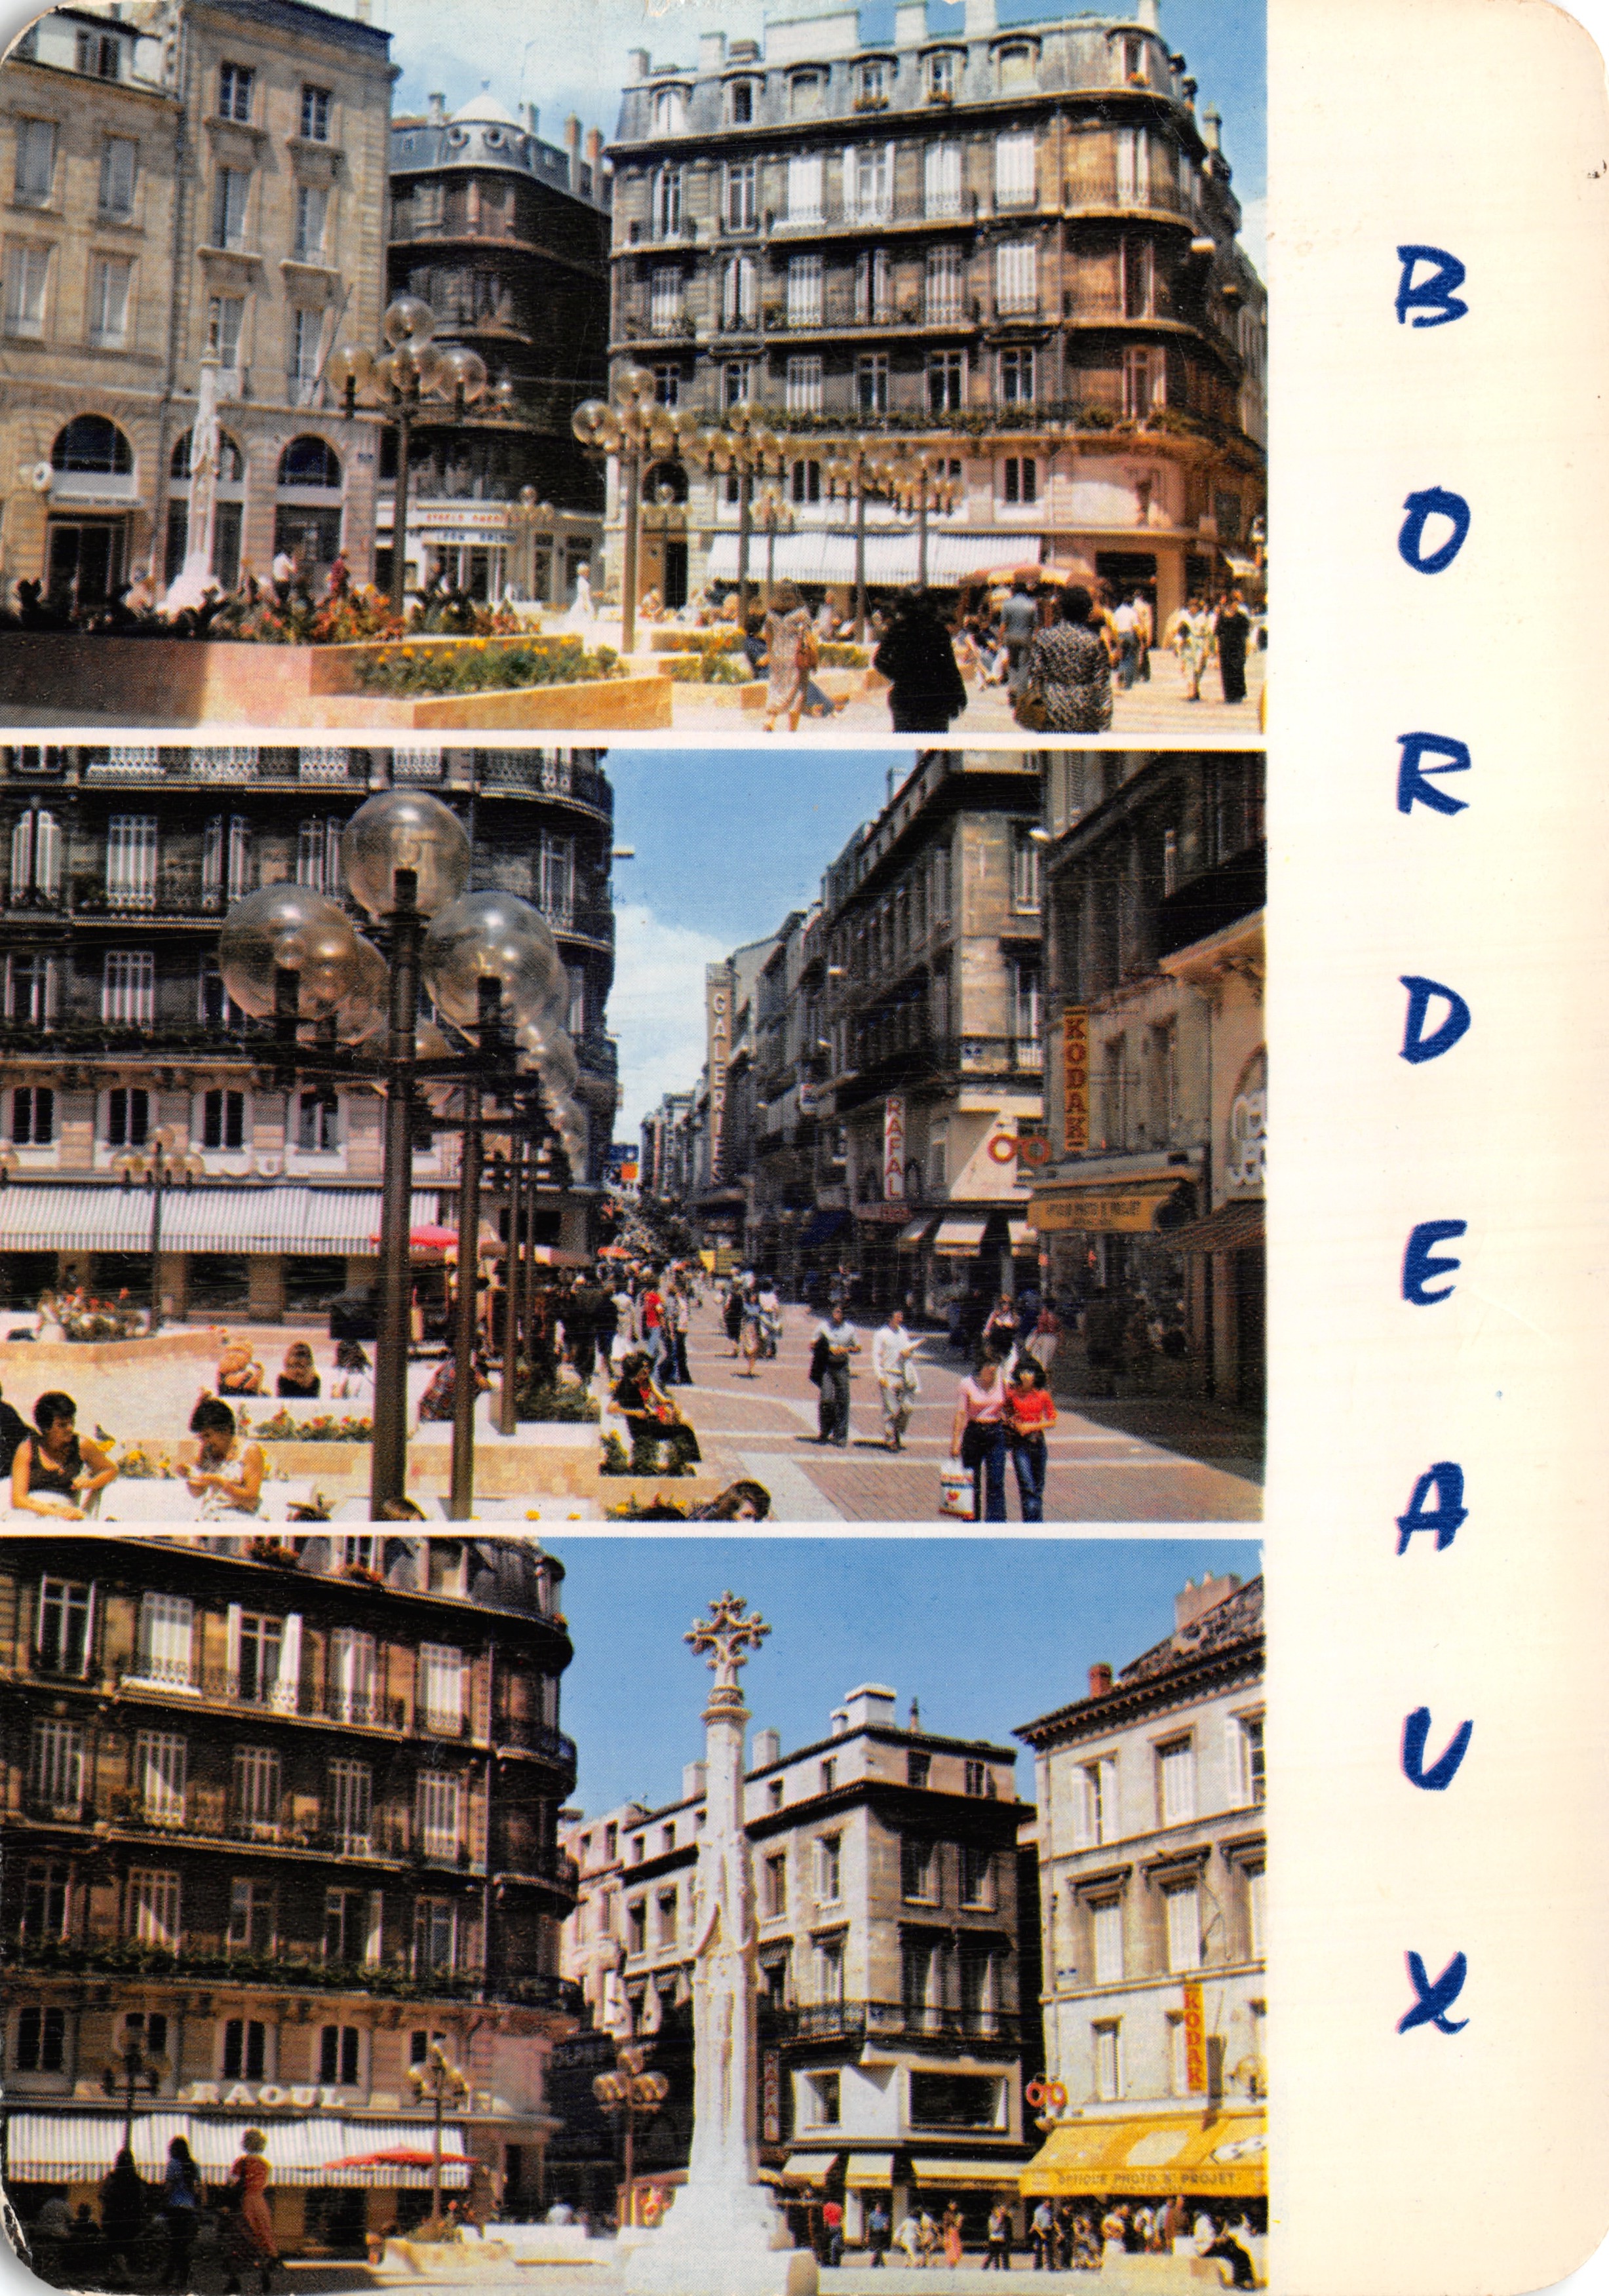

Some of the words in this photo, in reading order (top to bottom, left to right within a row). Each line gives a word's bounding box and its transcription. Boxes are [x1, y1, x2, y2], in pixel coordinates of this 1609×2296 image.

[712, 994, 727, 1182] GALERIES
[1066, 1018, 1086, 1138] KODAK
[885, 1097, 904, 1196] RAFAL
[1184, 1993, 1201, 2083] KODAK
[192, 2082, 345, 2109] RAOUL
